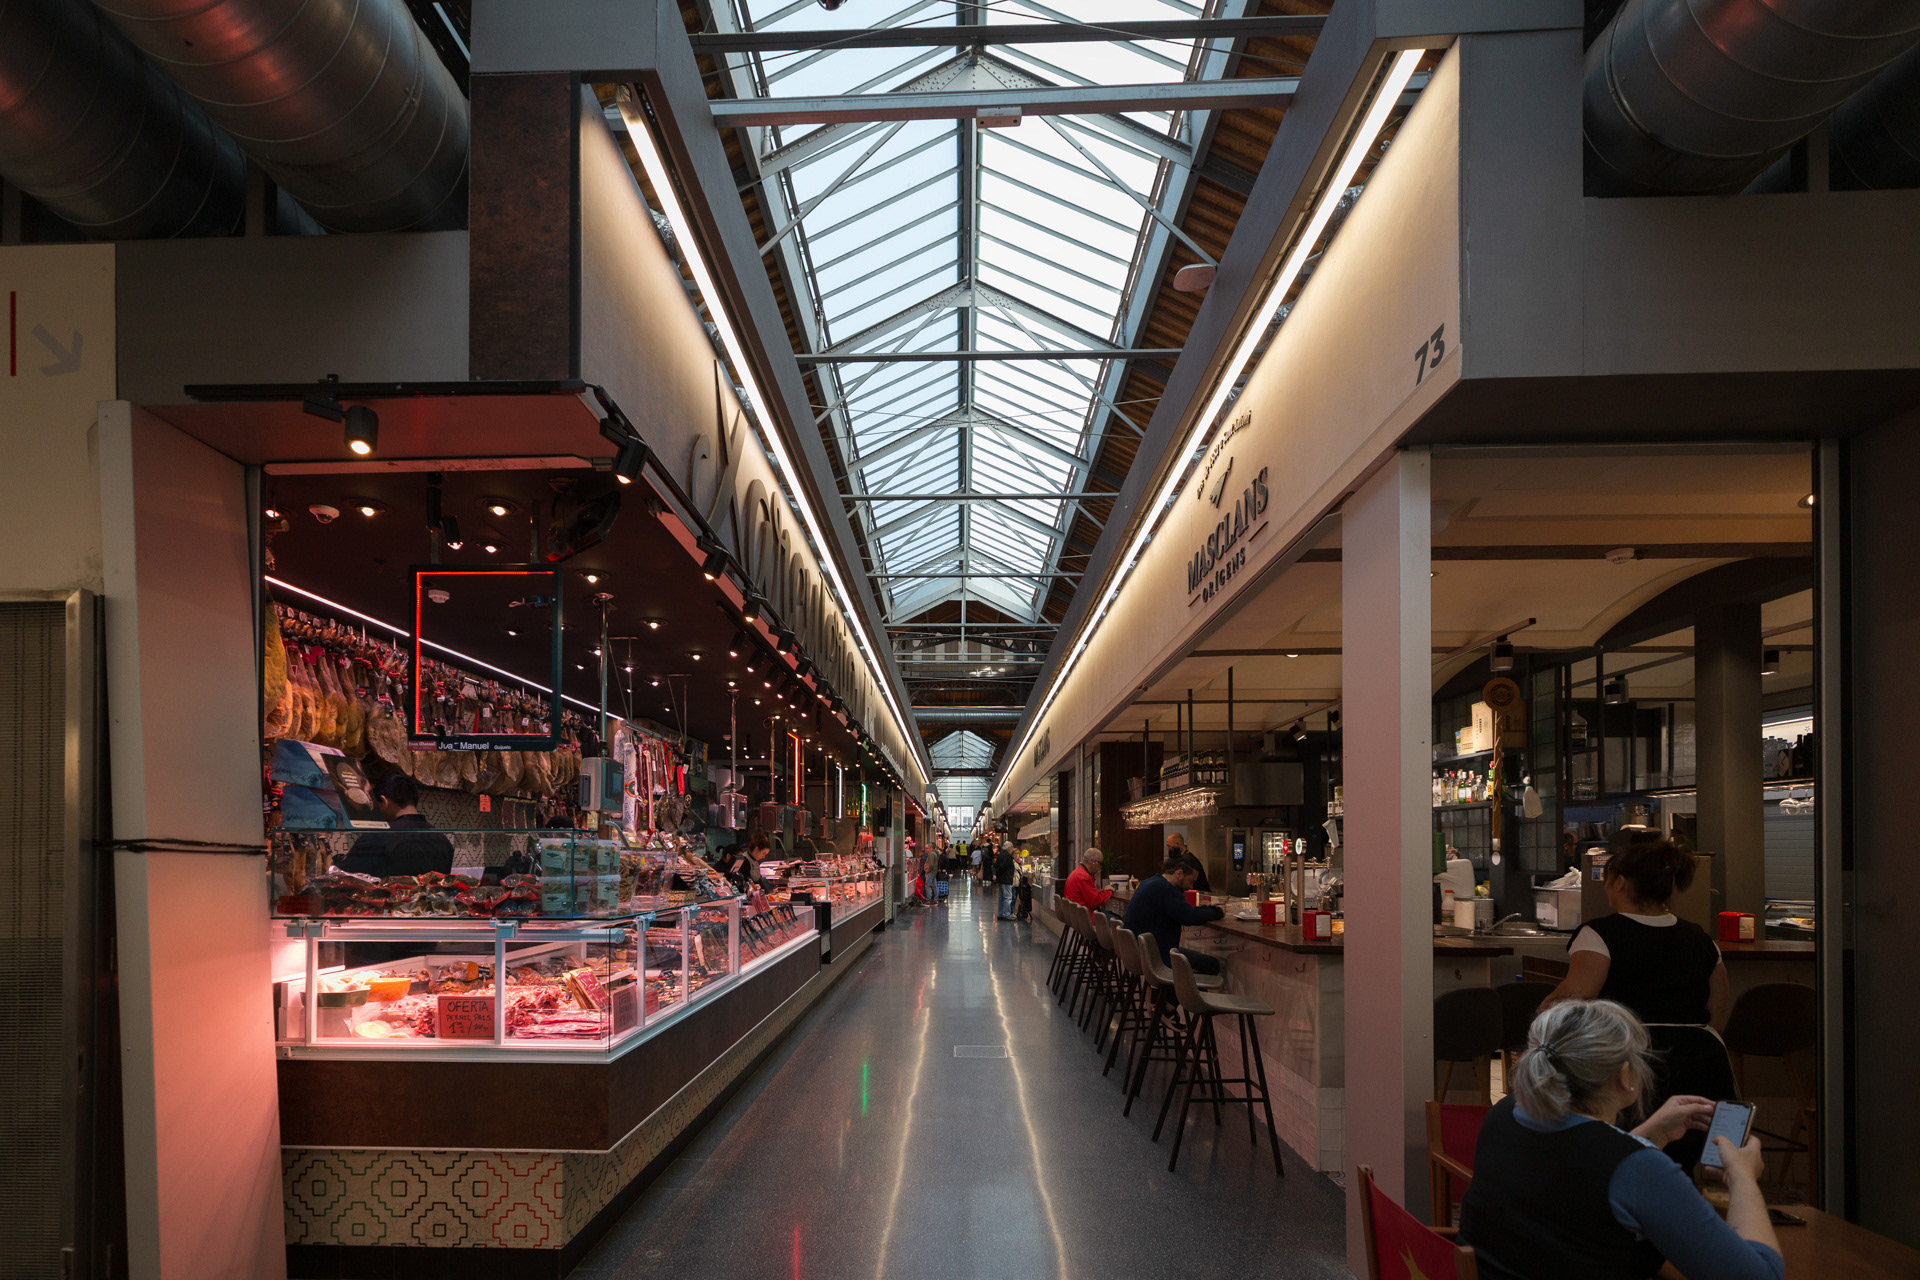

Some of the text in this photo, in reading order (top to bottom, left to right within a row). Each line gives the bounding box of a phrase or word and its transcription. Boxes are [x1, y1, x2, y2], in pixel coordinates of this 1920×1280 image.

[1415, 322, 1445, 387] 73
[1187, 466, 1269, 595] MASCLANS
[438, 741, 459, 751] Jua
[460, 741, 489, 750] Manuel
[447, 1000, 489, 1012] OFERTA
